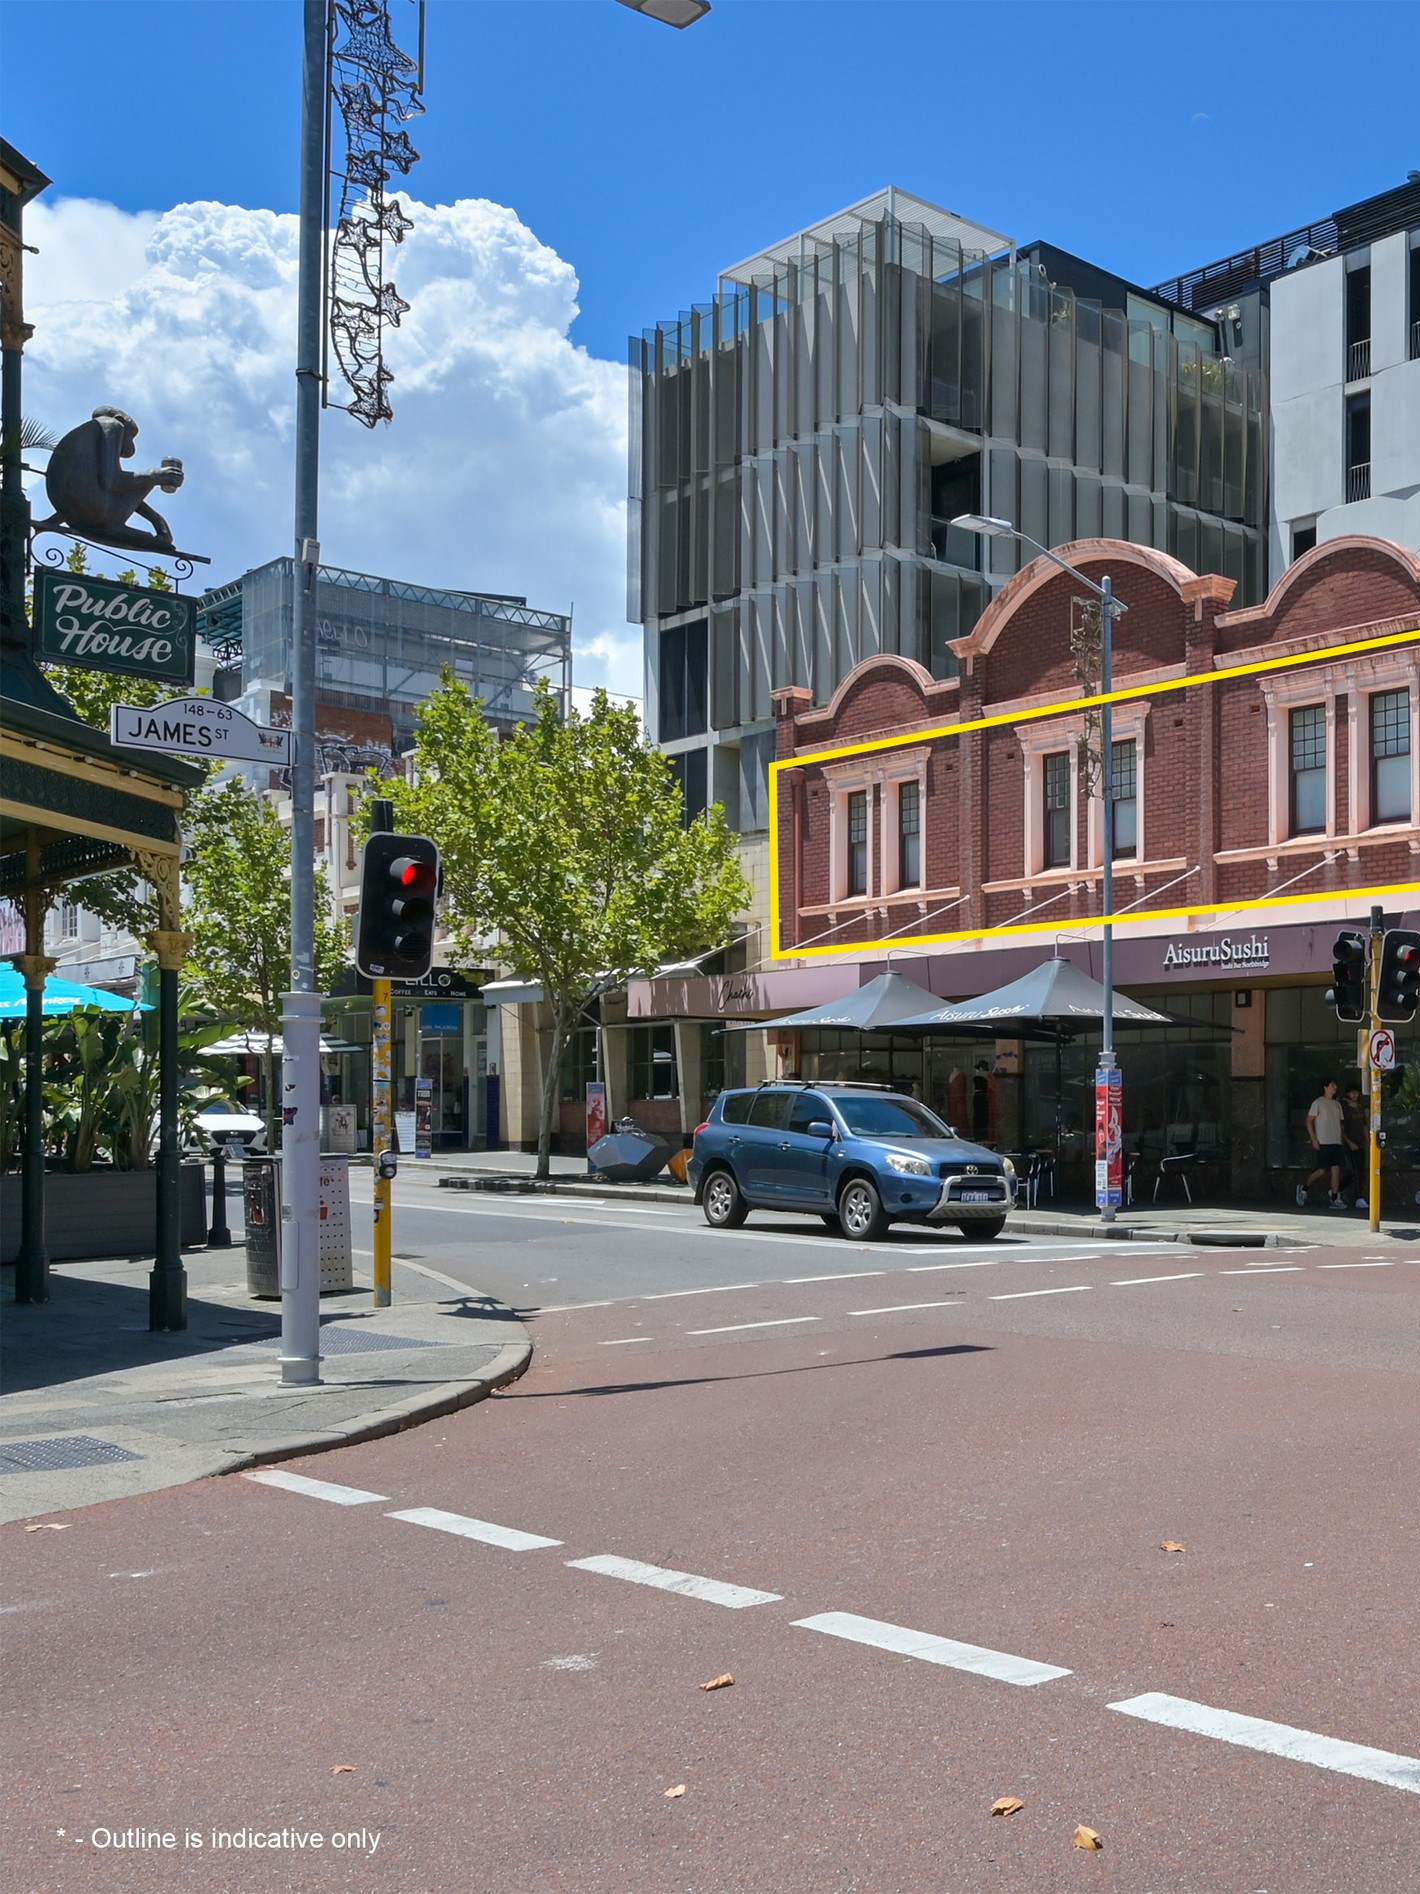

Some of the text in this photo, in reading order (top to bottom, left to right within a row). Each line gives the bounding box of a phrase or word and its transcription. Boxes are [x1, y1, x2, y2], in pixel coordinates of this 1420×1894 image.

[53, 585, 171, 628] Public
[56, 615, 172, 663] House
[128, 717, 229, 747] JAMES ST
